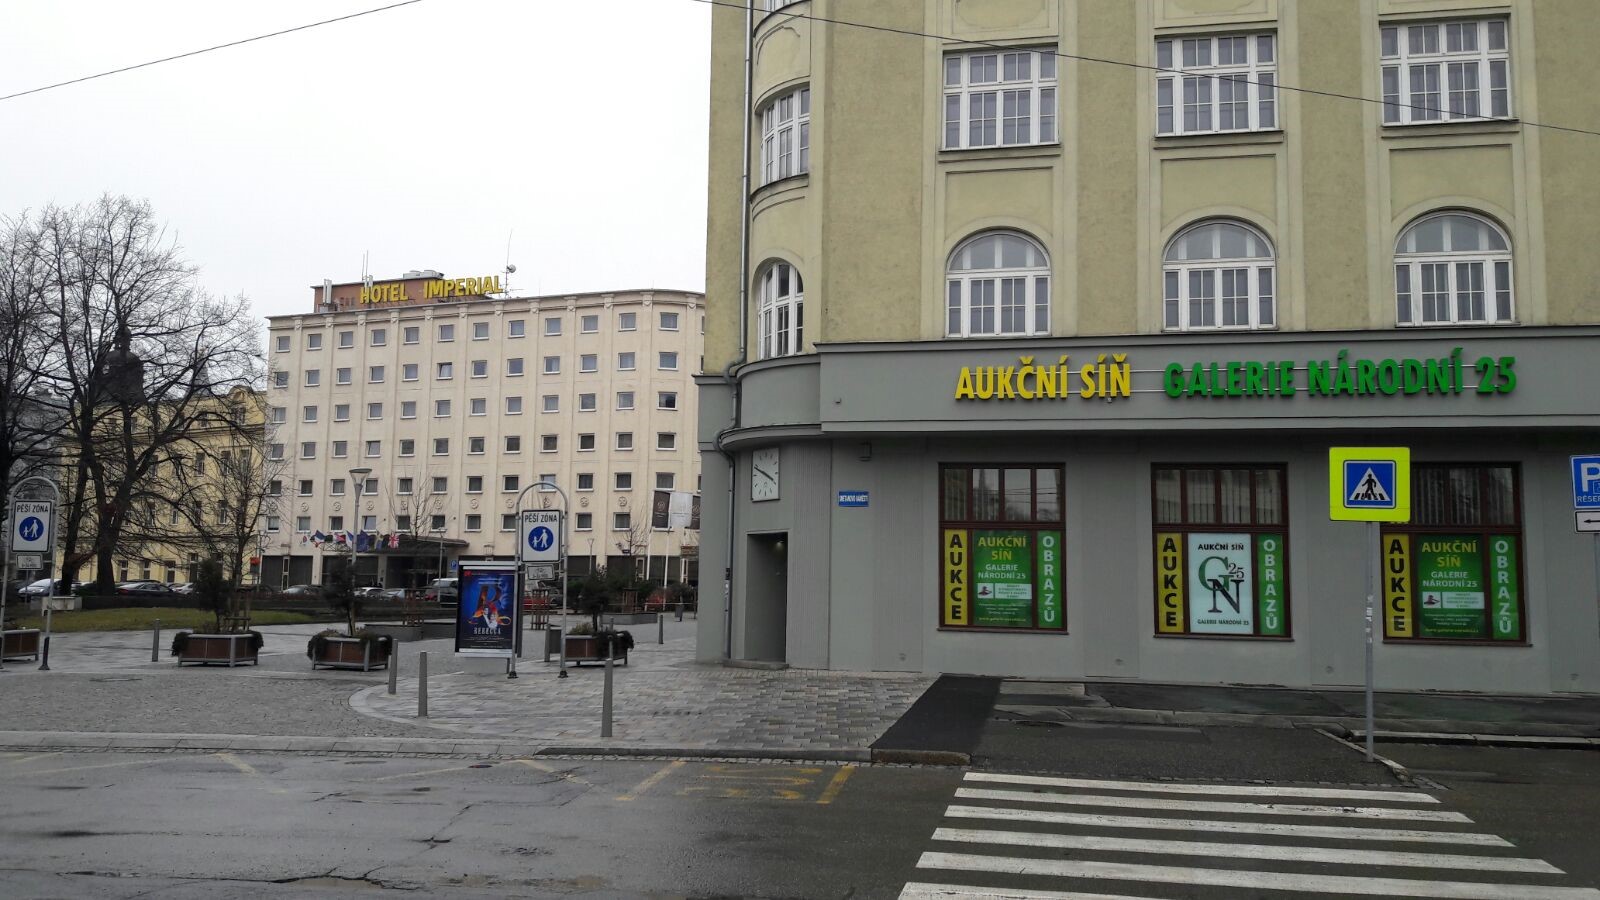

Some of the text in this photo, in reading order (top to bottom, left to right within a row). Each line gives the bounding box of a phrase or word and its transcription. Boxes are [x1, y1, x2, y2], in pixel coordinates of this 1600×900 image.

[360, 275, 503, 304] HOTEL IMPERIAL
[954, 353, 1131, 400] AUKČNÍ SÍŇ
[1163, 347, 1518, 398] GALERIE NÁRODNÍ 25
[1580, 463, 1600, 492] P
[32, 503, 49, 514] ZÓNA
[525, 513, 558, 523] PĚŠÍ ZÓNA
[977, 535, 1027, 548] AUKČNÍ
[1198, 543, 1229, 551] AUKČNÍ
[1421, 540, 1477, 553] AUKČNÍ
[991, 548, 1012, 561] SÍŇ
[1437, 555, 1461, 567] SÍŇ
[985, 563, 1018, 571] GALERIE
[949, 533, 963, 620] AUKCE
[978, 571, 1016, 579] NÁRODNÍ
[1042, 536, 1055, 622] OBRAZŮ
[1431, 571, 1468, 579] GALERIE
[1162, 537, 1177, 627] AUKCE
[1263, 539, 1277, 629] OBRAZŮ
[1389, 538, 1406, 632] AUKCE
[1422, 579, 1478, 588] NÁRODNÍ 25
[1494, 540, 1512, 633] OBRAZŮ
